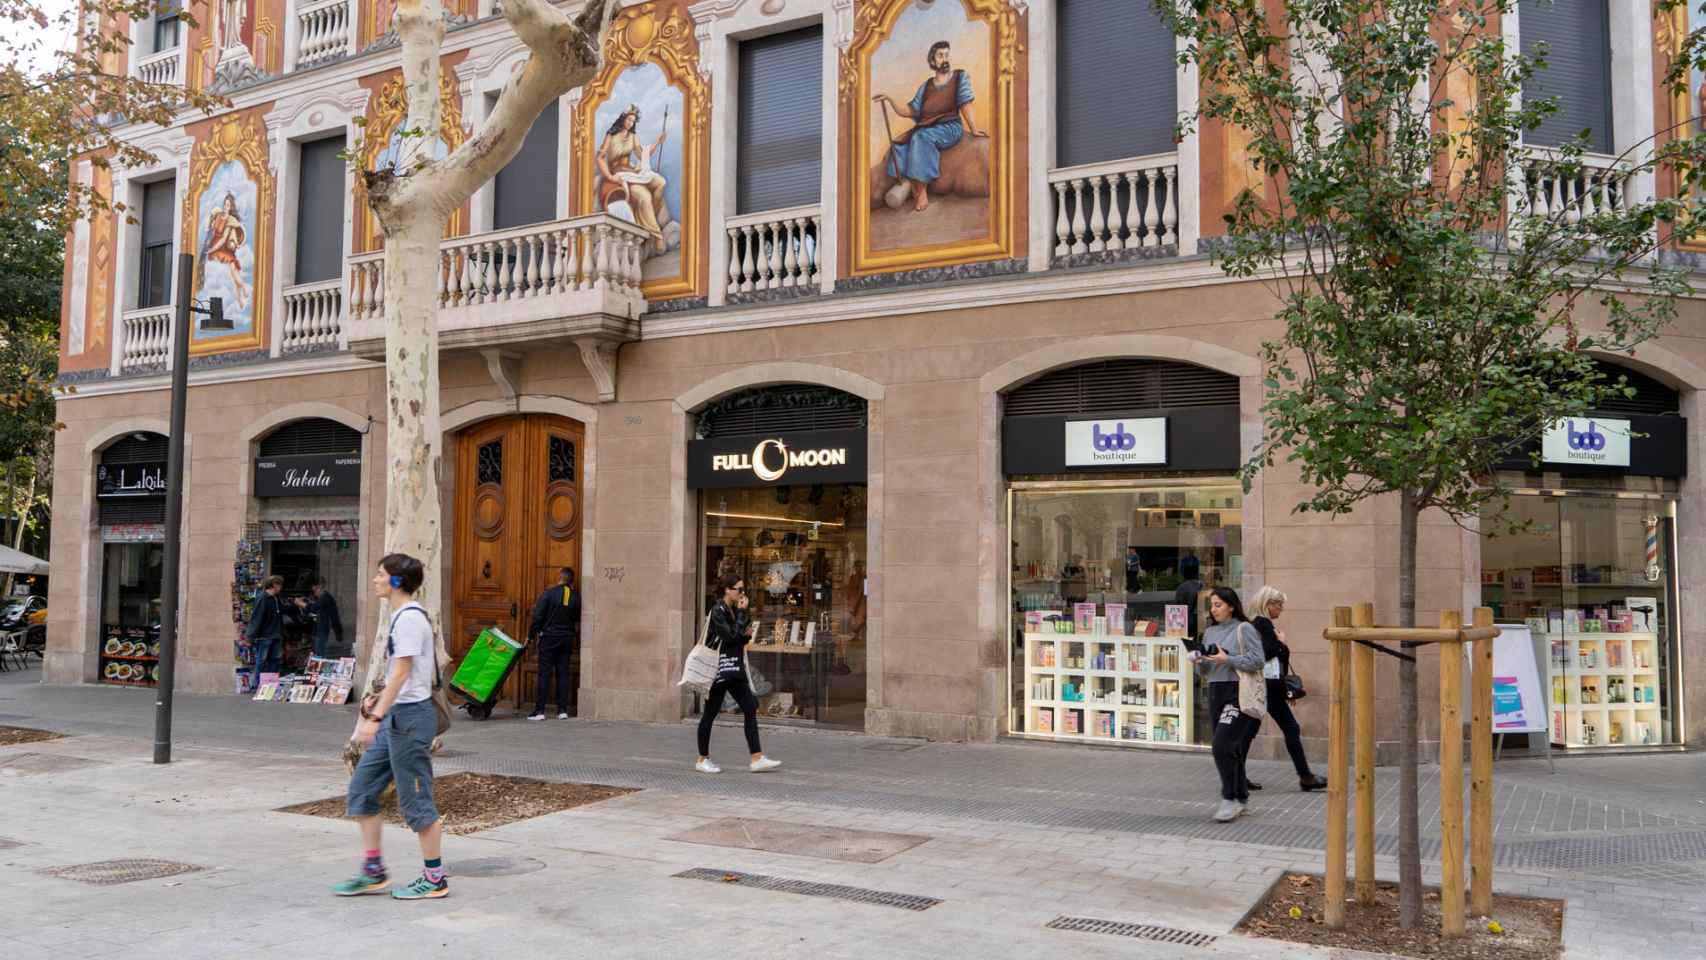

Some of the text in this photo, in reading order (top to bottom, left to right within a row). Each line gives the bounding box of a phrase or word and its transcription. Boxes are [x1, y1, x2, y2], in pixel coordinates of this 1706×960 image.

[712, 448, 846, 470] FULL MOON
[1093, 452, 1137, 461] boutique
[1567, 451, 1606, 462] boutique
